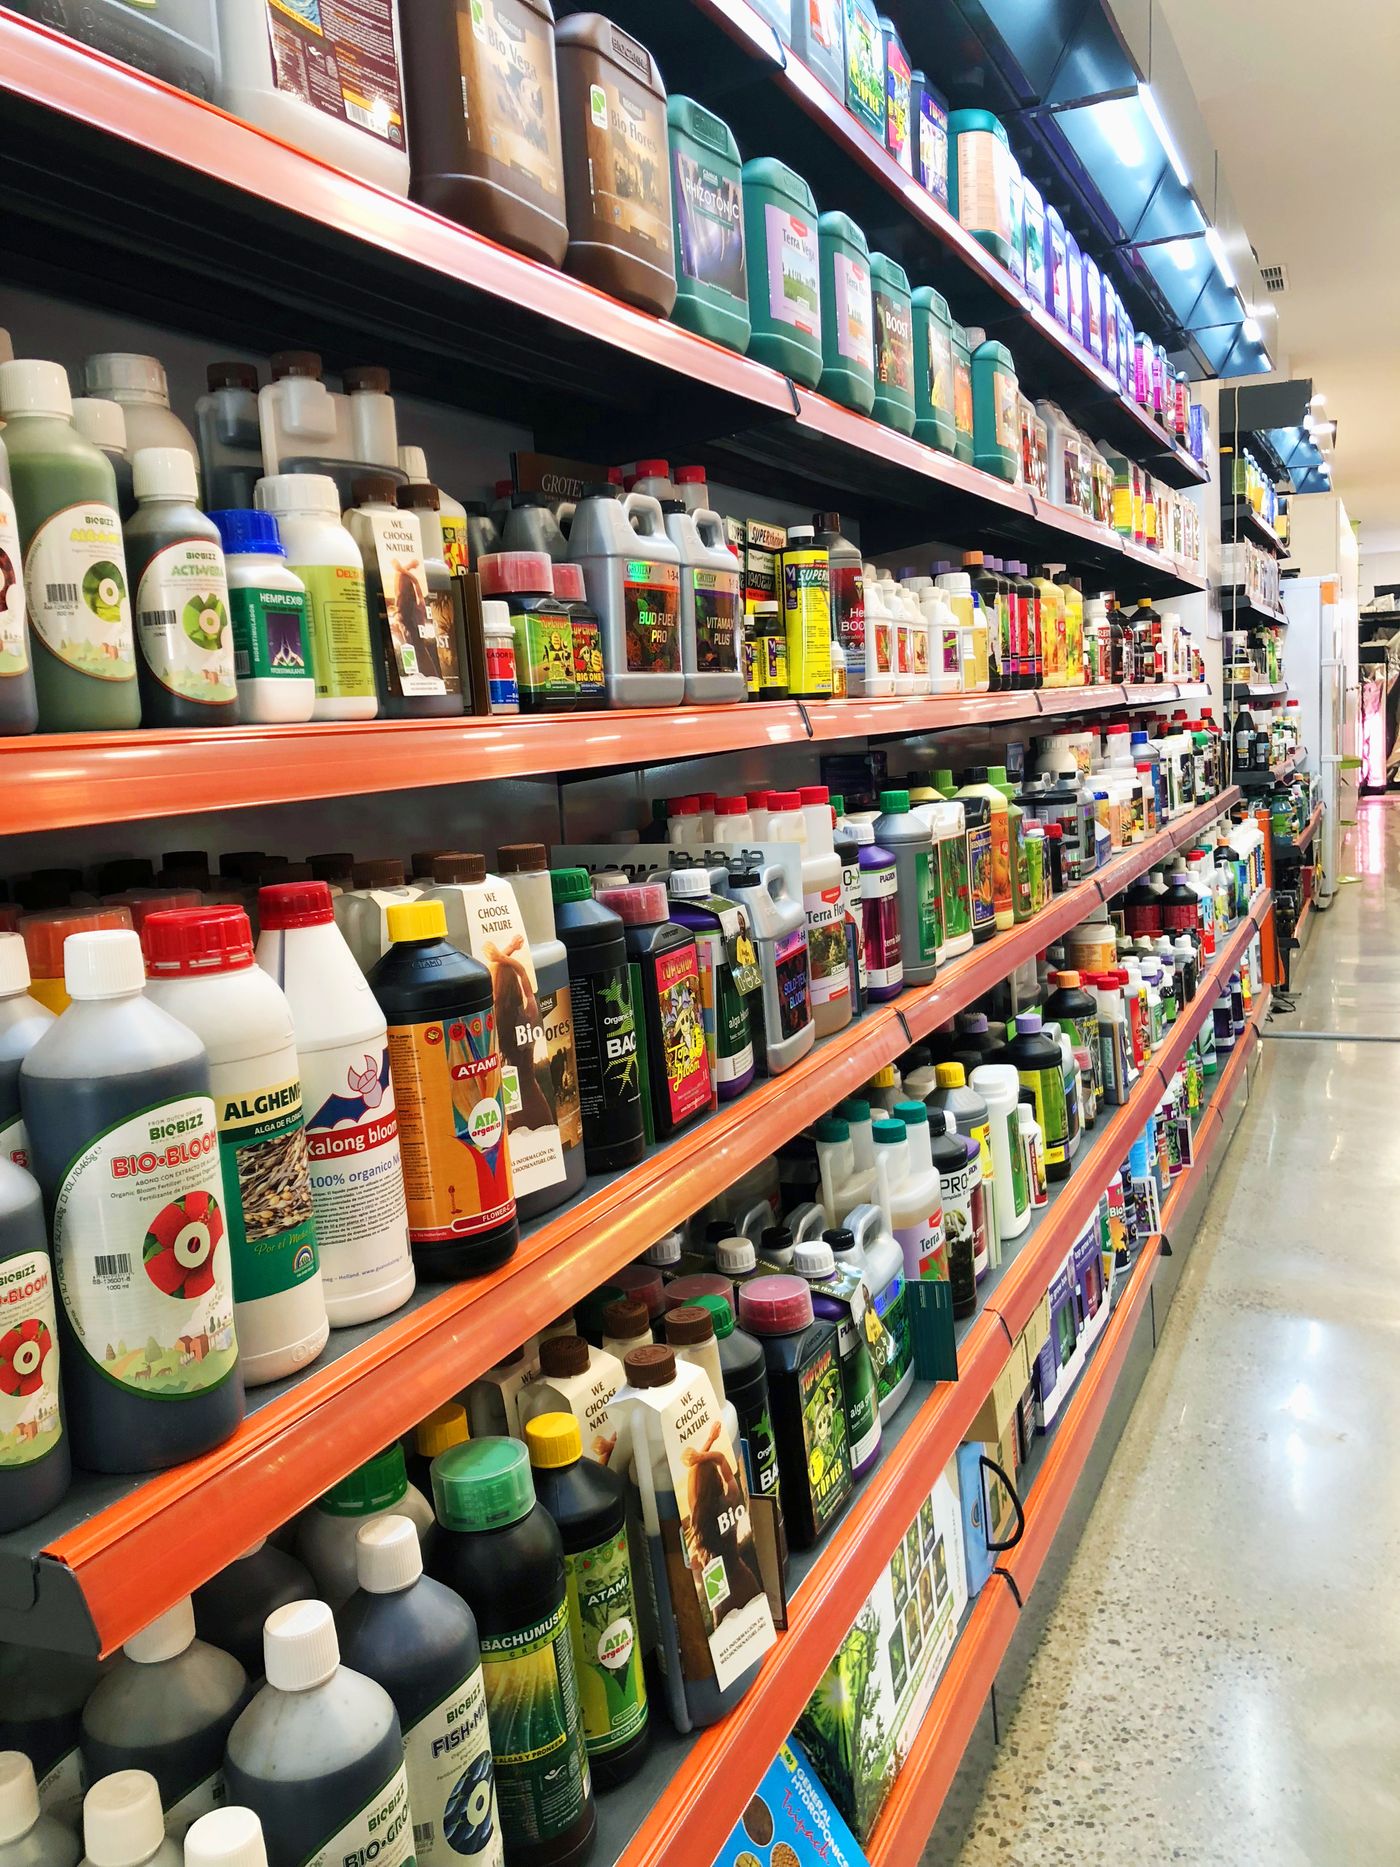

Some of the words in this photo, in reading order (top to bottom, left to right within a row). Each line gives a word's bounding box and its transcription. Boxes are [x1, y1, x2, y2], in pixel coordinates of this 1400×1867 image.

[488, 27, 506, 57] Bio
[510, 43, 538, 80] Vega
[611, 110, 628, 133] Bio
[630, 120, 658, 153] Flores
[685, 177, 740, 219] RHIZOTONIC
[782, 228, 801, 252] Terra
[885, 310, 909, 338] BOOST
[391, 519, 404, 531] WE
[383, 531, 414, 544] CHOOSE
[387, 544, 415, 556] NATURE
[639, 611, 657, 626] BUD
[657, 613, 675, 627] FUEL
[850, 606, 865, 619] He
[841, 621, 865, 633] BOO
[651, 630, 668, 644] PRO
[714, 633, 731, 646] PLUS
[484, 892, 497, 902] WE
[478, 904, 510, 919] CHOOSE
[806, 906, 833, 925] Terra
[481, 920, 513, 934] NATURE
[729, 1016, 741, 1029] alga
[516, 1022, 545, 1047] Bio
[457, 1057, 497, 1078] ATAMI
[149, 1113, 204, 1141] BIOBIZZ
[254, 1125, 277, 1136] ALGA
[276, 1119, 285, 1129] DE
[474, 1109, 498, 1128] ATA
[307, 1134, 366, 1156] Kalong
[310, 1173, 345, 1188] 100%
[111, 1191, 135, 1200] Organic
[137, 1187, 156, 1195] Bloom
[482, 1205, 510, 1223] FLOWER-C
[919, 1231, 941, 1253] Terra
[590, 1380, 605, 1397] WE
[584, 1388, 618, 1418] CHOOSE
[680, 1390, 694, 1408] WE
[675, 1397, 707, 1430] CHOOSE
[850, 1400, 865, 1420] alga
[679, 1411, 711, 1443] NATURE
[816, 1476, 831, 1499] TOP
[829, 1459, 843, 1486] VEG
[717, 1503, 746, 1536] Bio
[587, 1575, 628, 1607] ATAMI
[604, 1629, 629, 1652] ATA
[796, 1768, 831, 1828] GENERAL
[790, 1775, 849, 1867] HYDROPONICS
